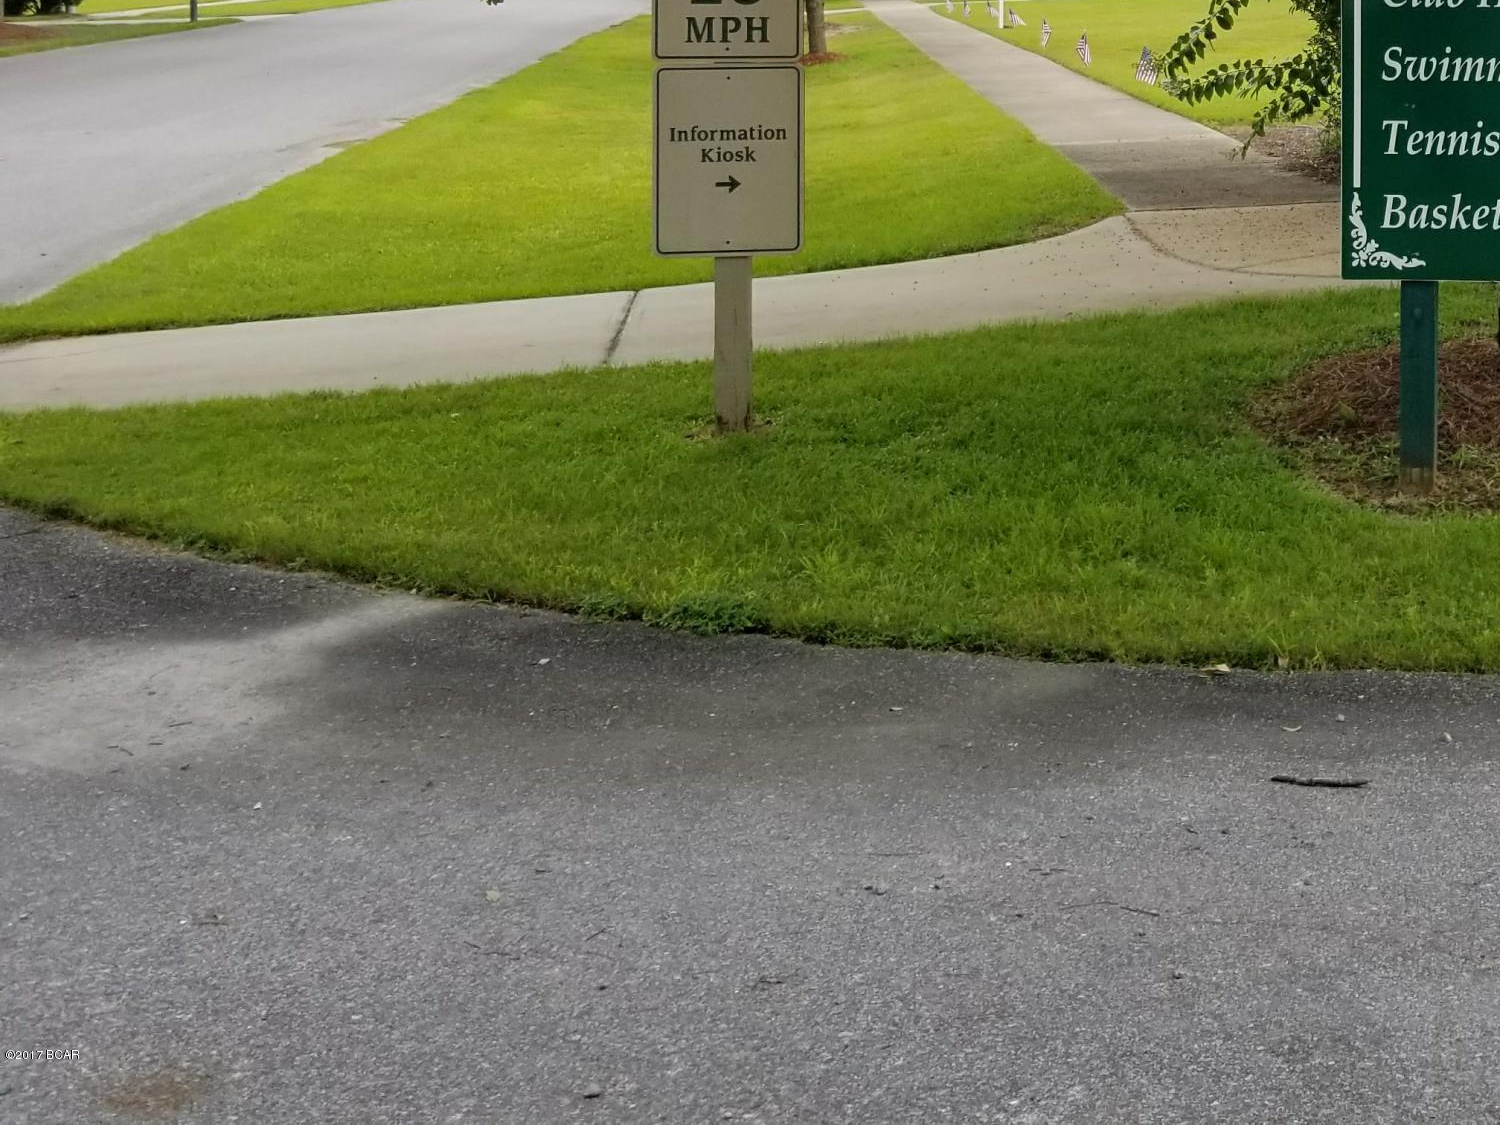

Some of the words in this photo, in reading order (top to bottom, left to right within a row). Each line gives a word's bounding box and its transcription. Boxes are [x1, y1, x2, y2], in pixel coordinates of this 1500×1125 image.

[685, 17, 769, 43] MPH
[669, 125, 787, 142] Information
[1382, 120, 1500, 157] Tennis
[700, 146, 756, 163] Kiosk
